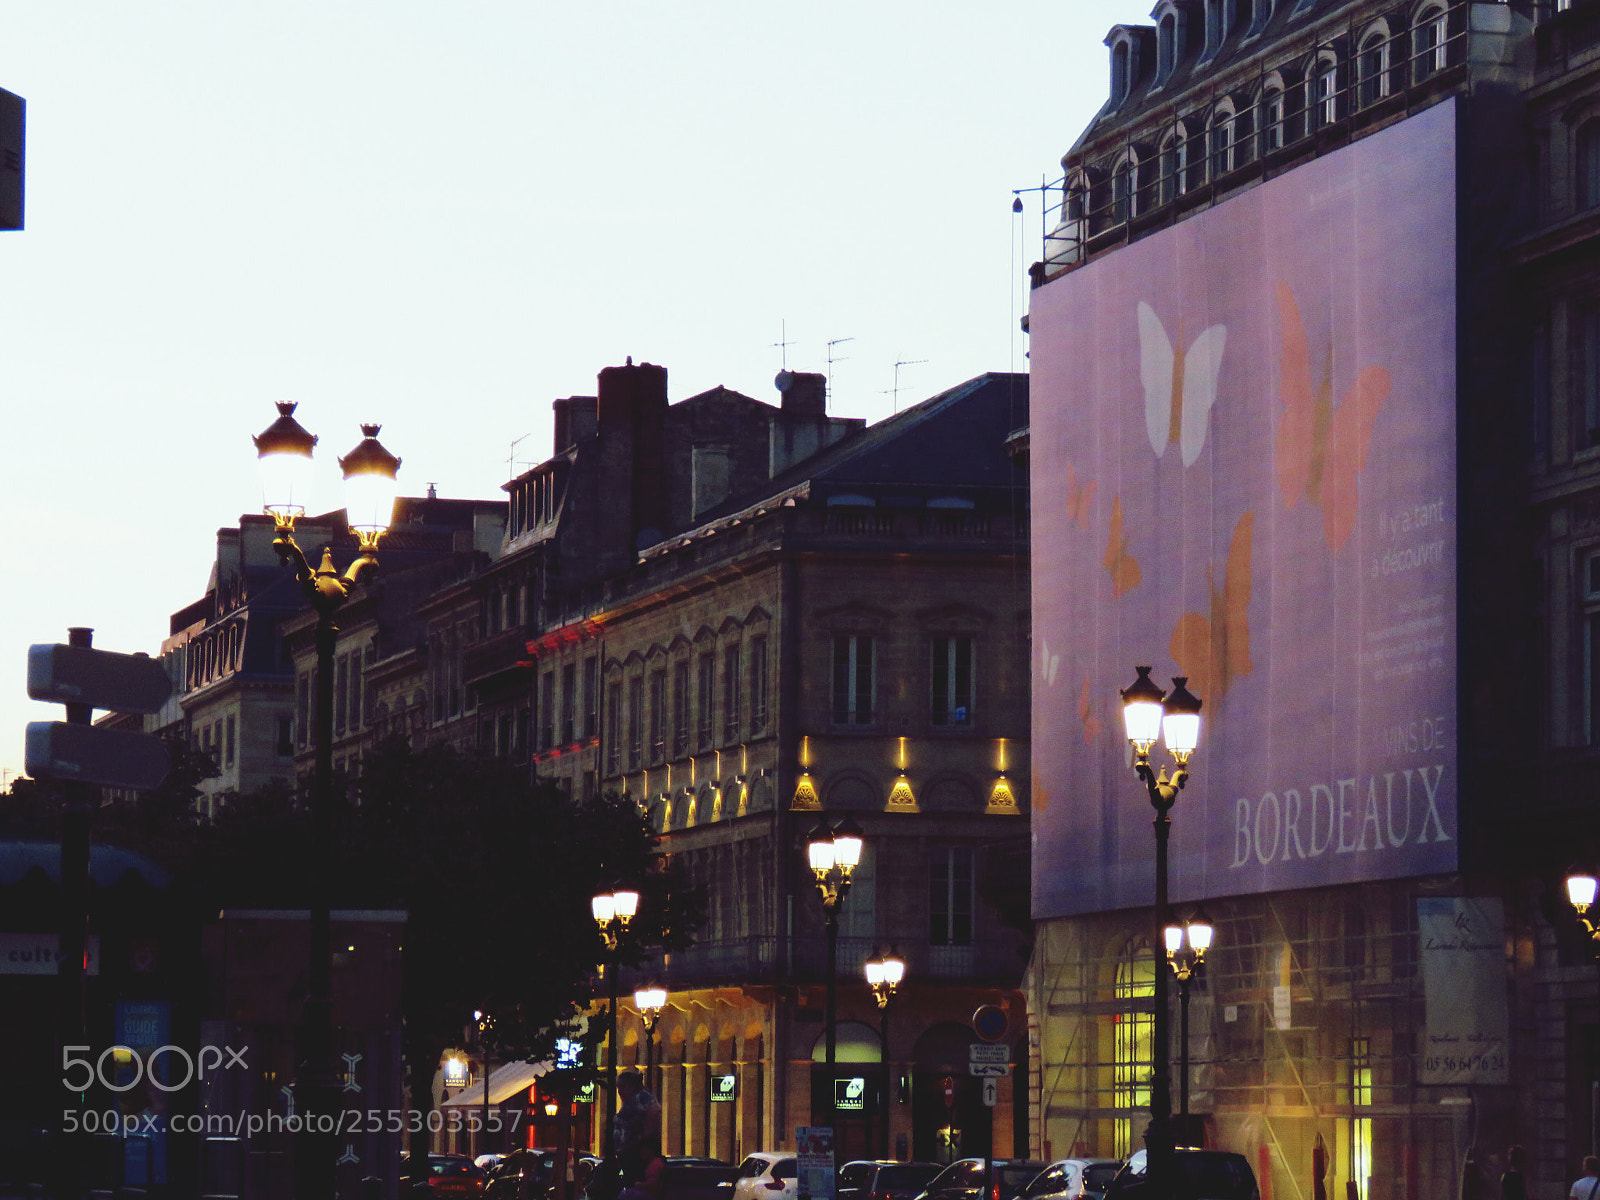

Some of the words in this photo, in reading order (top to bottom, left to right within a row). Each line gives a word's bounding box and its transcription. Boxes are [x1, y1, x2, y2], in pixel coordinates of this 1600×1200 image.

[1414, 497, 1444, 529] tant
[1381, 540, 1445, 576] découvrir
[1383, 721, 1418, 757] VINS
[1422, 716, 1445, 752] DE
[1229, 765, 1453, 869] BORDEAUX
